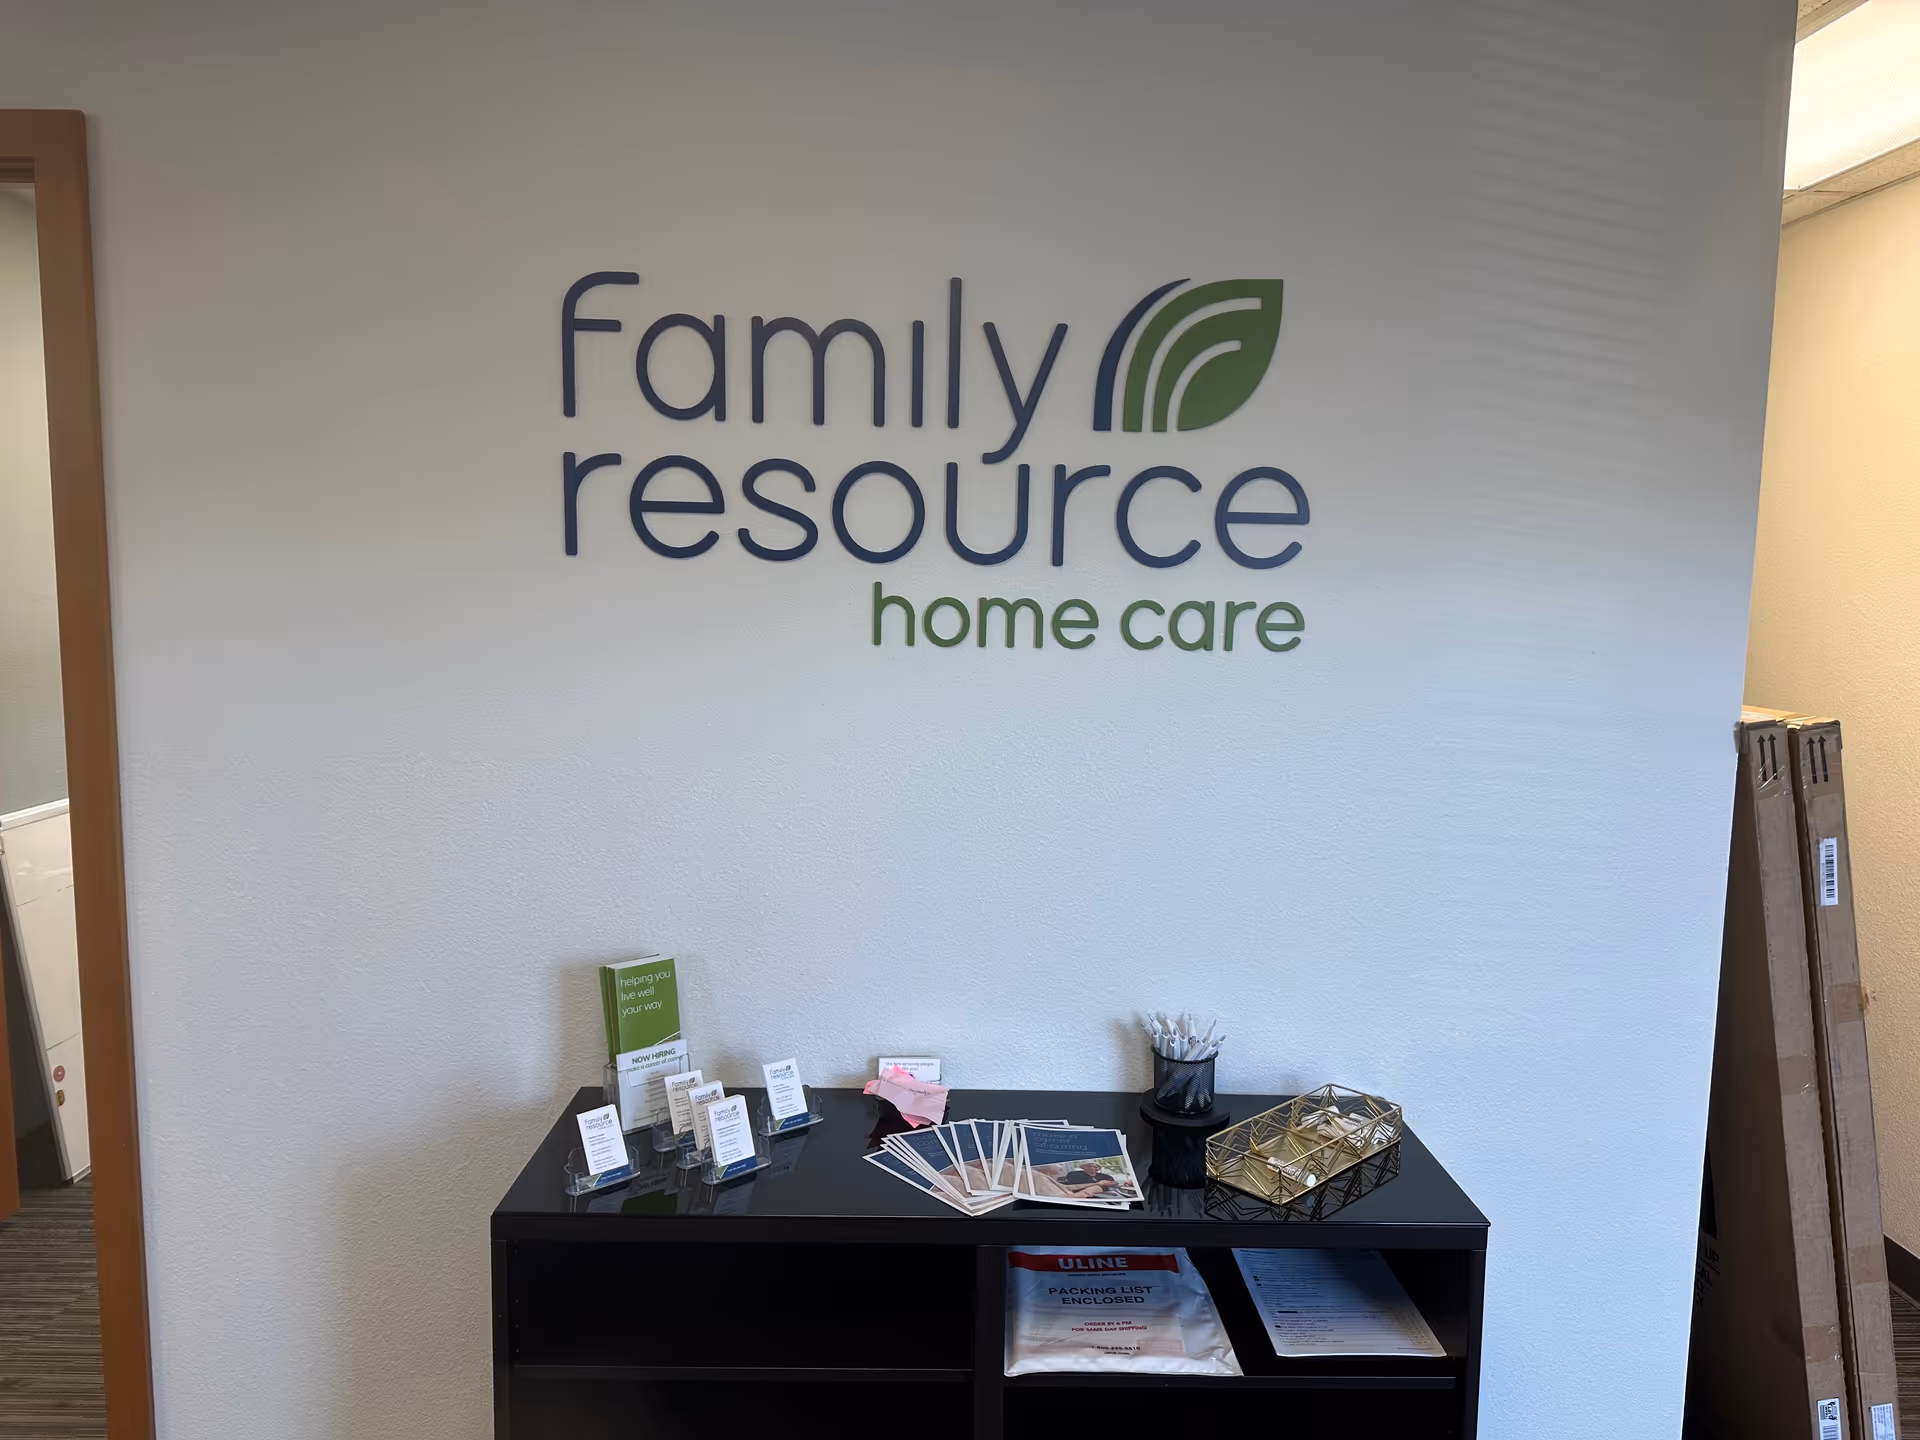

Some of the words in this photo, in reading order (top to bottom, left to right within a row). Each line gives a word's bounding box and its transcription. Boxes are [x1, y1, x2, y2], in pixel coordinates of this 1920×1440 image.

[562, 271, 1068, 464] family
[562, 451, 1310, 569] resource
[871, 581, 1099, 649] home
[1119, 598, 1305, 652] care
[620, 974, 653, 988] helping
[654, 970, 670, 982] you
[621, 991, 636, 1001] live
[637, 986, 655, 998] well
[622, 1004, 642, 1018] your
[644, 1000, 662, 1010] way
[632, 1054, 650, 1064] NOW
[652, 1048, 676, 1060] HIRING
[672, 1079, 688, 1088] family
[672, 1082, 698, 1092] resource
[695, 1092, 711, 1101] family
[696, 1095, 720, 1106] resource
[714, 1107, 731, 1117] family
[715, 1111, 740, 1122] resource
[584, 1114, 603, 1126] family
[586, 1119, 612, 1131] resource
[1058, 1257, 1129, 1270] ULINE
[1048, 1287, 1116, 1295] PACKING
[1062, 1296, 1145, 1304] ENCLOSED
